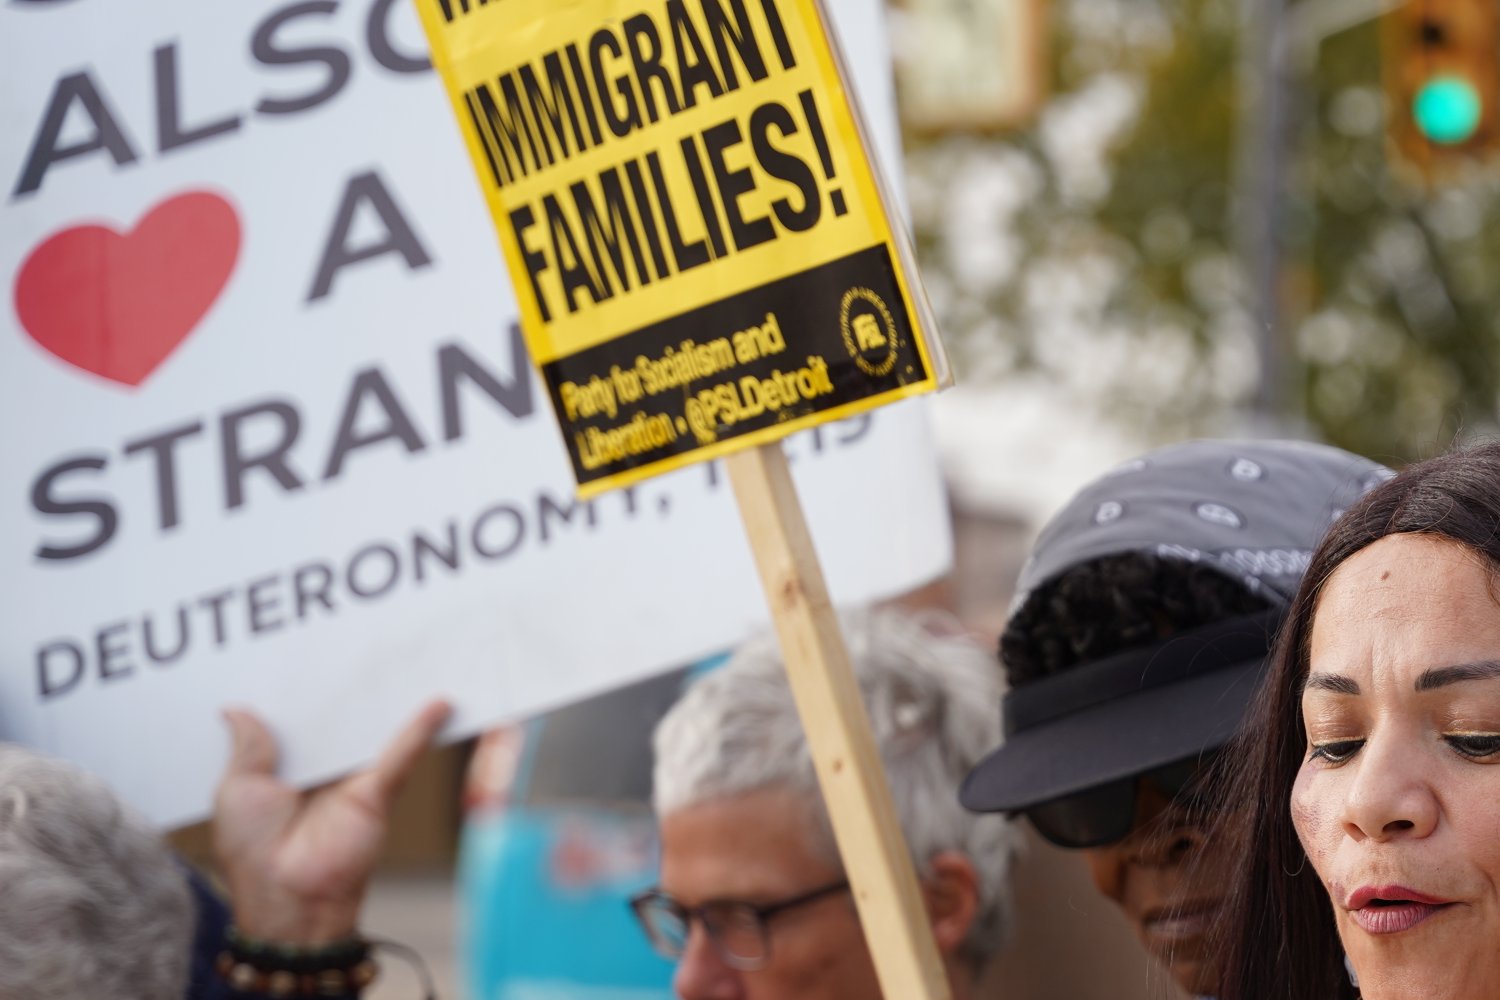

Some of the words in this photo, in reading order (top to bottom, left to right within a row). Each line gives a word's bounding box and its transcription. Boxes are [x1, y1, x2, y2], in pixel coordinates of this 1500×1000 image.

[463, 0, 798, 188] IMMIGRANT
[304, 168, 436, 304] A
[508, 88, 849, 324] FAMILIES!
[560, 375, 618, 420] Party
[610, 364, 644, 404] for
[635, 338, 737, 396] Socialism
[732, 312, 787, 365] and
[574, 410, 678, 471] Liberation
[685, 354, 835, 445] @PSLDetroit
